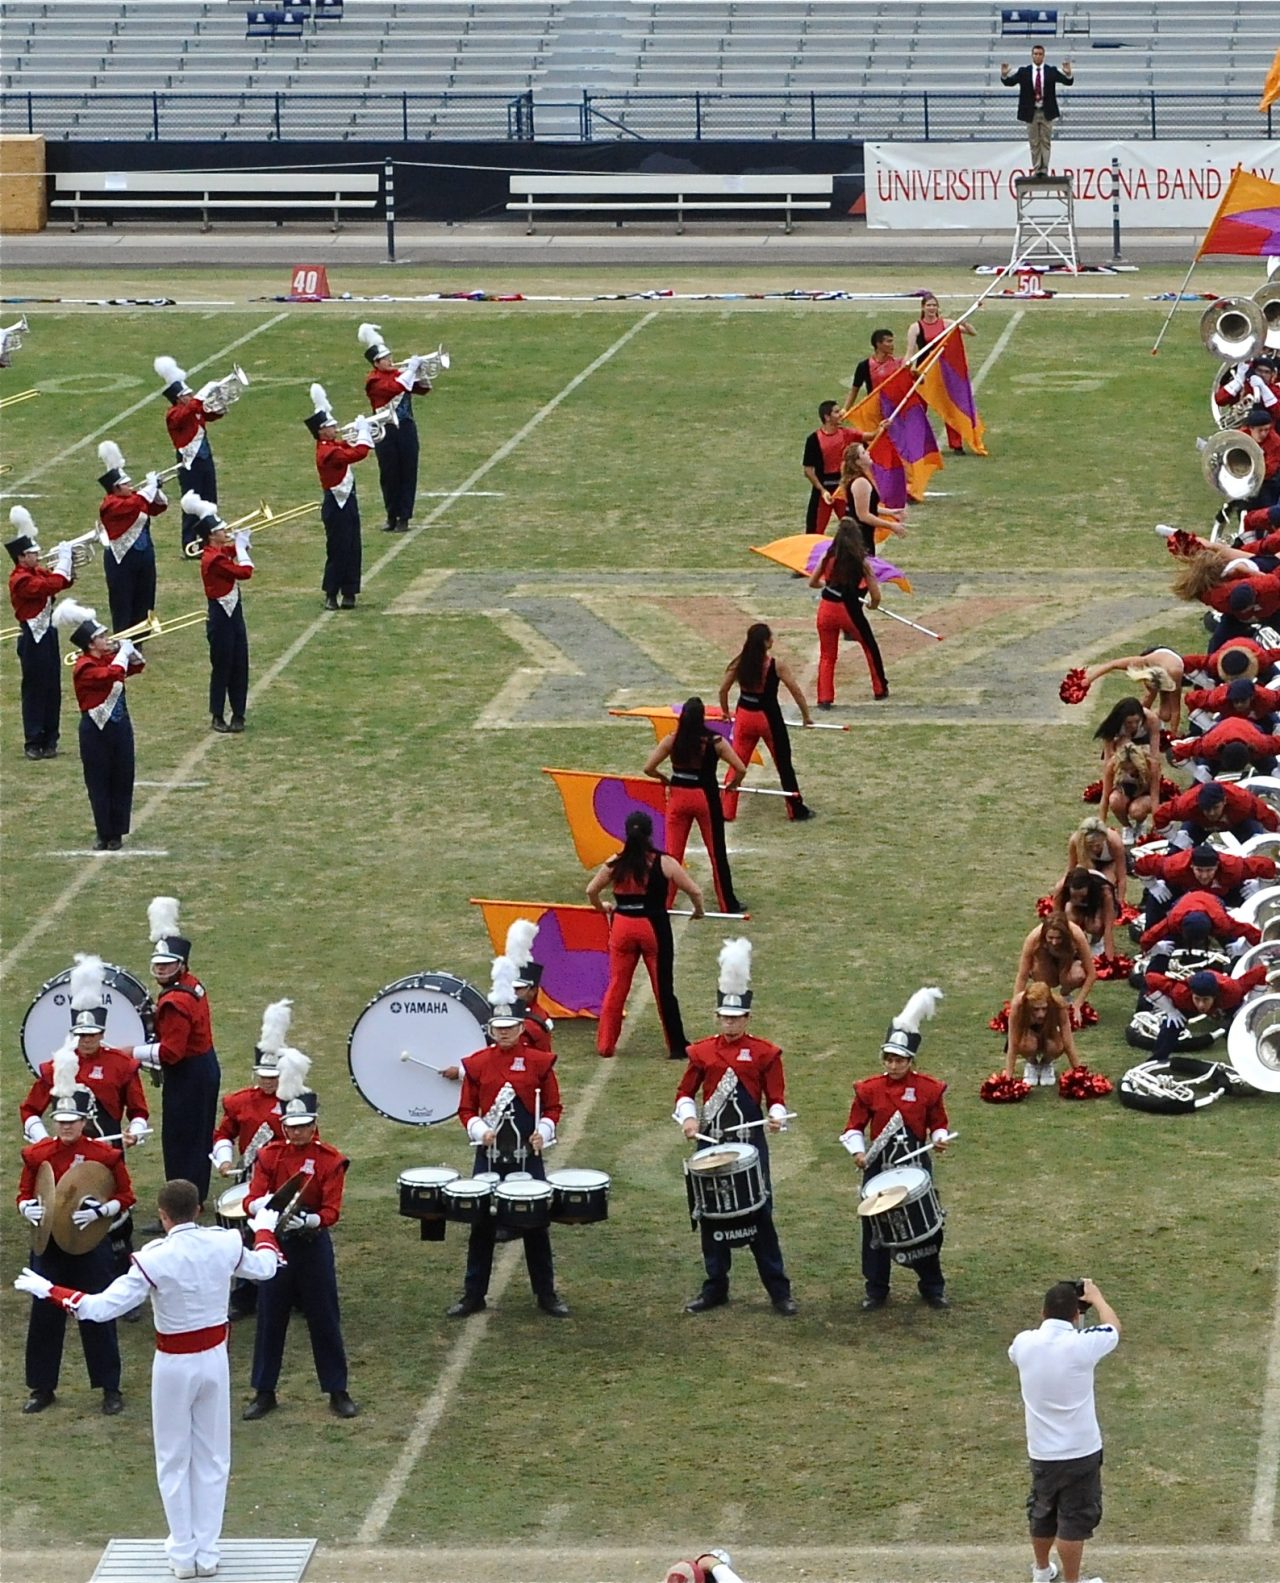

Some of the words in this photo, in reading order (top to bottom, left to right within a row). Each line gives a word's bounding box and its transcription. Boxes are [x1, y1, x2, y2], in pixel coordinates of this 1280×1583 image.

[876, 169, 1001, 201] UNIVERSITY
[1050, 167, 1150, 201] RIZONA
[1156, 168, 1222, 200] BAND
[293, 270, 318, 294] 40
[1019, 275, 1039, 293] 50
[404, 1002, 448, 1014] YAMAHA
[724, 1225, 758, 1241] YAMAHA
